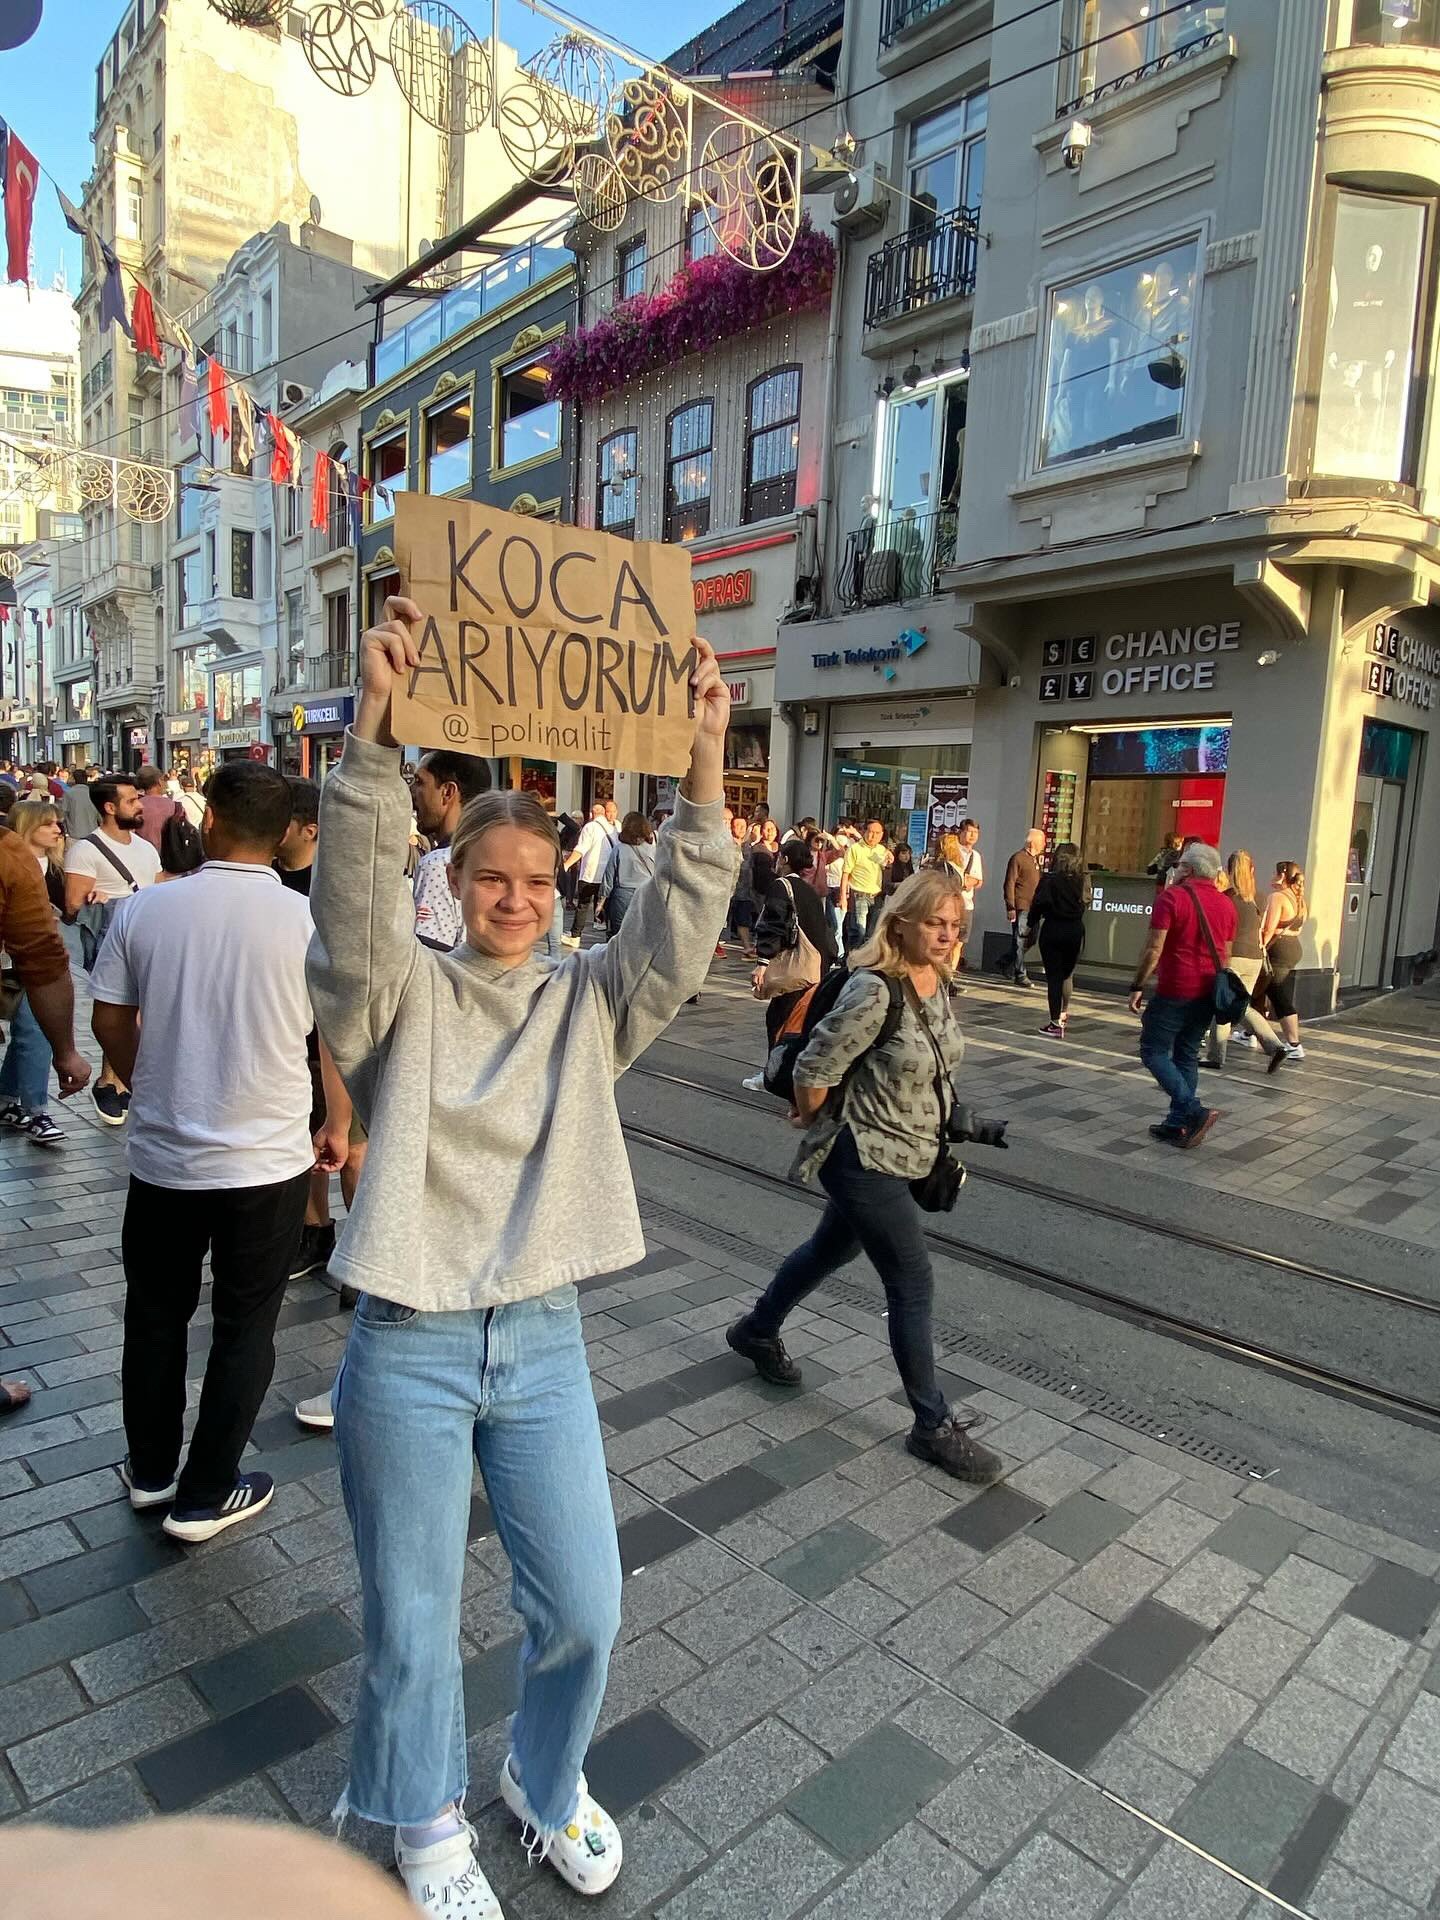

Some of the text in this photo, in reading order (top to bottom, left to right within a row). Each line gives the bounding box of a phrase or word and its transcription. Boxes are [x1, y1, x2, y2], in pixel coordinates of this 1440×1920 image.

[232, 535, 241, 594] CHANGE
[447, 520, 670, 636] KOCA
[843, 646, 900, 664] Telekom
[1105, 621, 1241, 661] CHANGE
[407, 614, 698, 719] ARIYORUM
[1102, 661, 1216, 695] OFFICE
[1396, 672, 1437, 708] OFFICE
[304, 706, 340, 725] TURKCELL
[442, 713, 612, 757] @_polinalit
[1105, 902, 1144, 914] CHANGE
